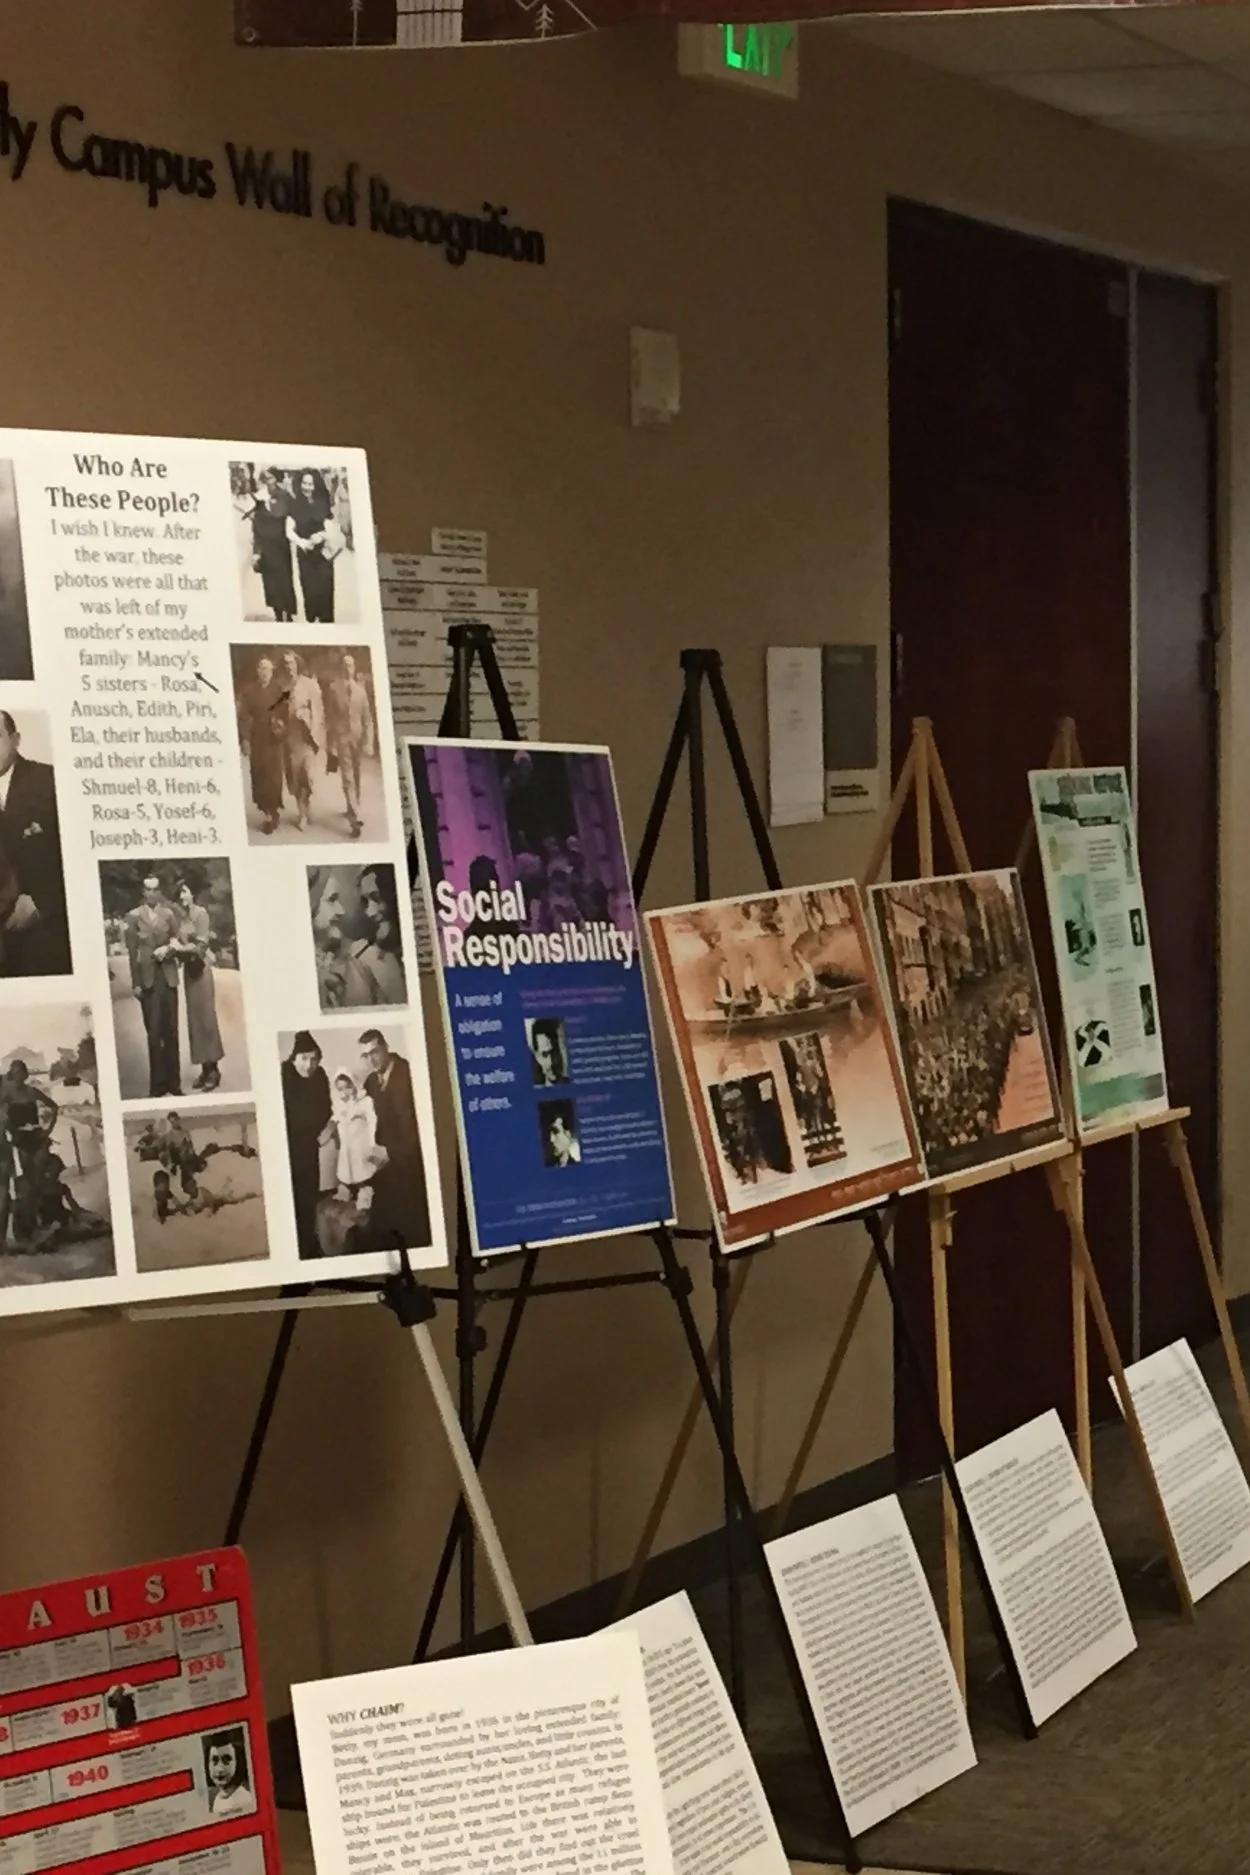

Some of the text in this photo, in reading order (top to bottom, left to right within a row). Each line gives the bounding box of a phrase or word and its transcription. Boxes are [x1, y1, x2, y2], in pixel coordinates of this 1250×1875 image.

[51, 105, 217, 208] Campus
[225, 141, 312, 218] Wall
[323, 161, 360, 227] of
[369, 174, 546, 267] Recognition
[73, 453, 168, 478] Who Are
[45, 486, 200, 518] These People?
[50, 518, 57, 536] I
[61, 520, 98, 536] wish
[163, 522, 201, 540] After
[74, 546, 100, 563] the
[142, 548, 184, 565] these
[53, 570, 208, 591] photos were all that
[80, 598, 188, 620] was left of my
[64, 623, 208, 641] mother's extended
[96, 675, 148, 692] sisters
[161, 676, 202, 694] Rosa,
[136, 700, 182, 719] Edith,
[70, 725, 222, 745] Ela, their husbands,
[73, 751, 213, 769] and their children
[436, 880, 527, 924] Social
[442, 922, 634, 975] Responsibility
[61, 1703, 100, 1726] 1937
[327, 1702, 405, 1725] WHY CHAIM?
[67, 1765, 109, 1787] 1940
